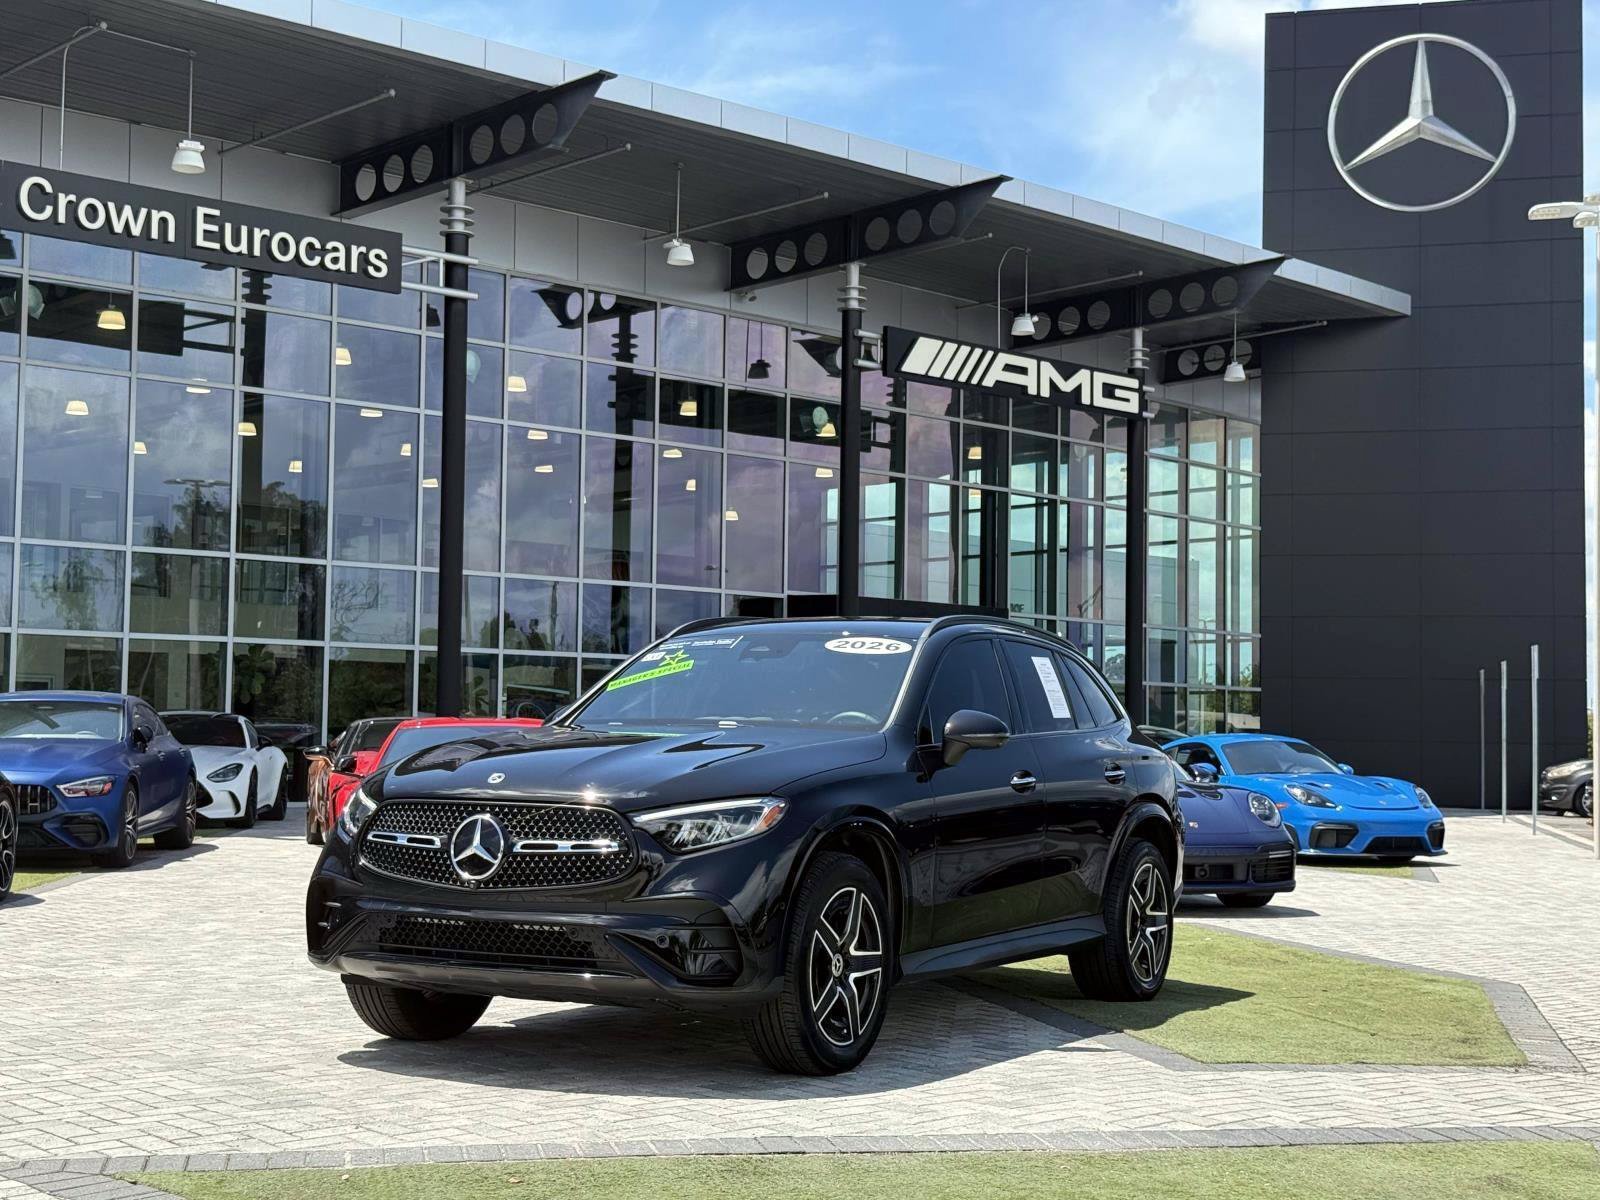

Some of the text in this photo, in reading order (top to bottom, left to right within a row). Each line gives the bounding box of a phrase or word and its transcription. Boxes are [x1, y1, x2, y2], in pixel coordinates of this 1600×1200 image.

[18, 175, 389, 279] Crown Eurocars
[981, 351, 1140, 414] AMG
[833, 640, 901, 652] 2026
